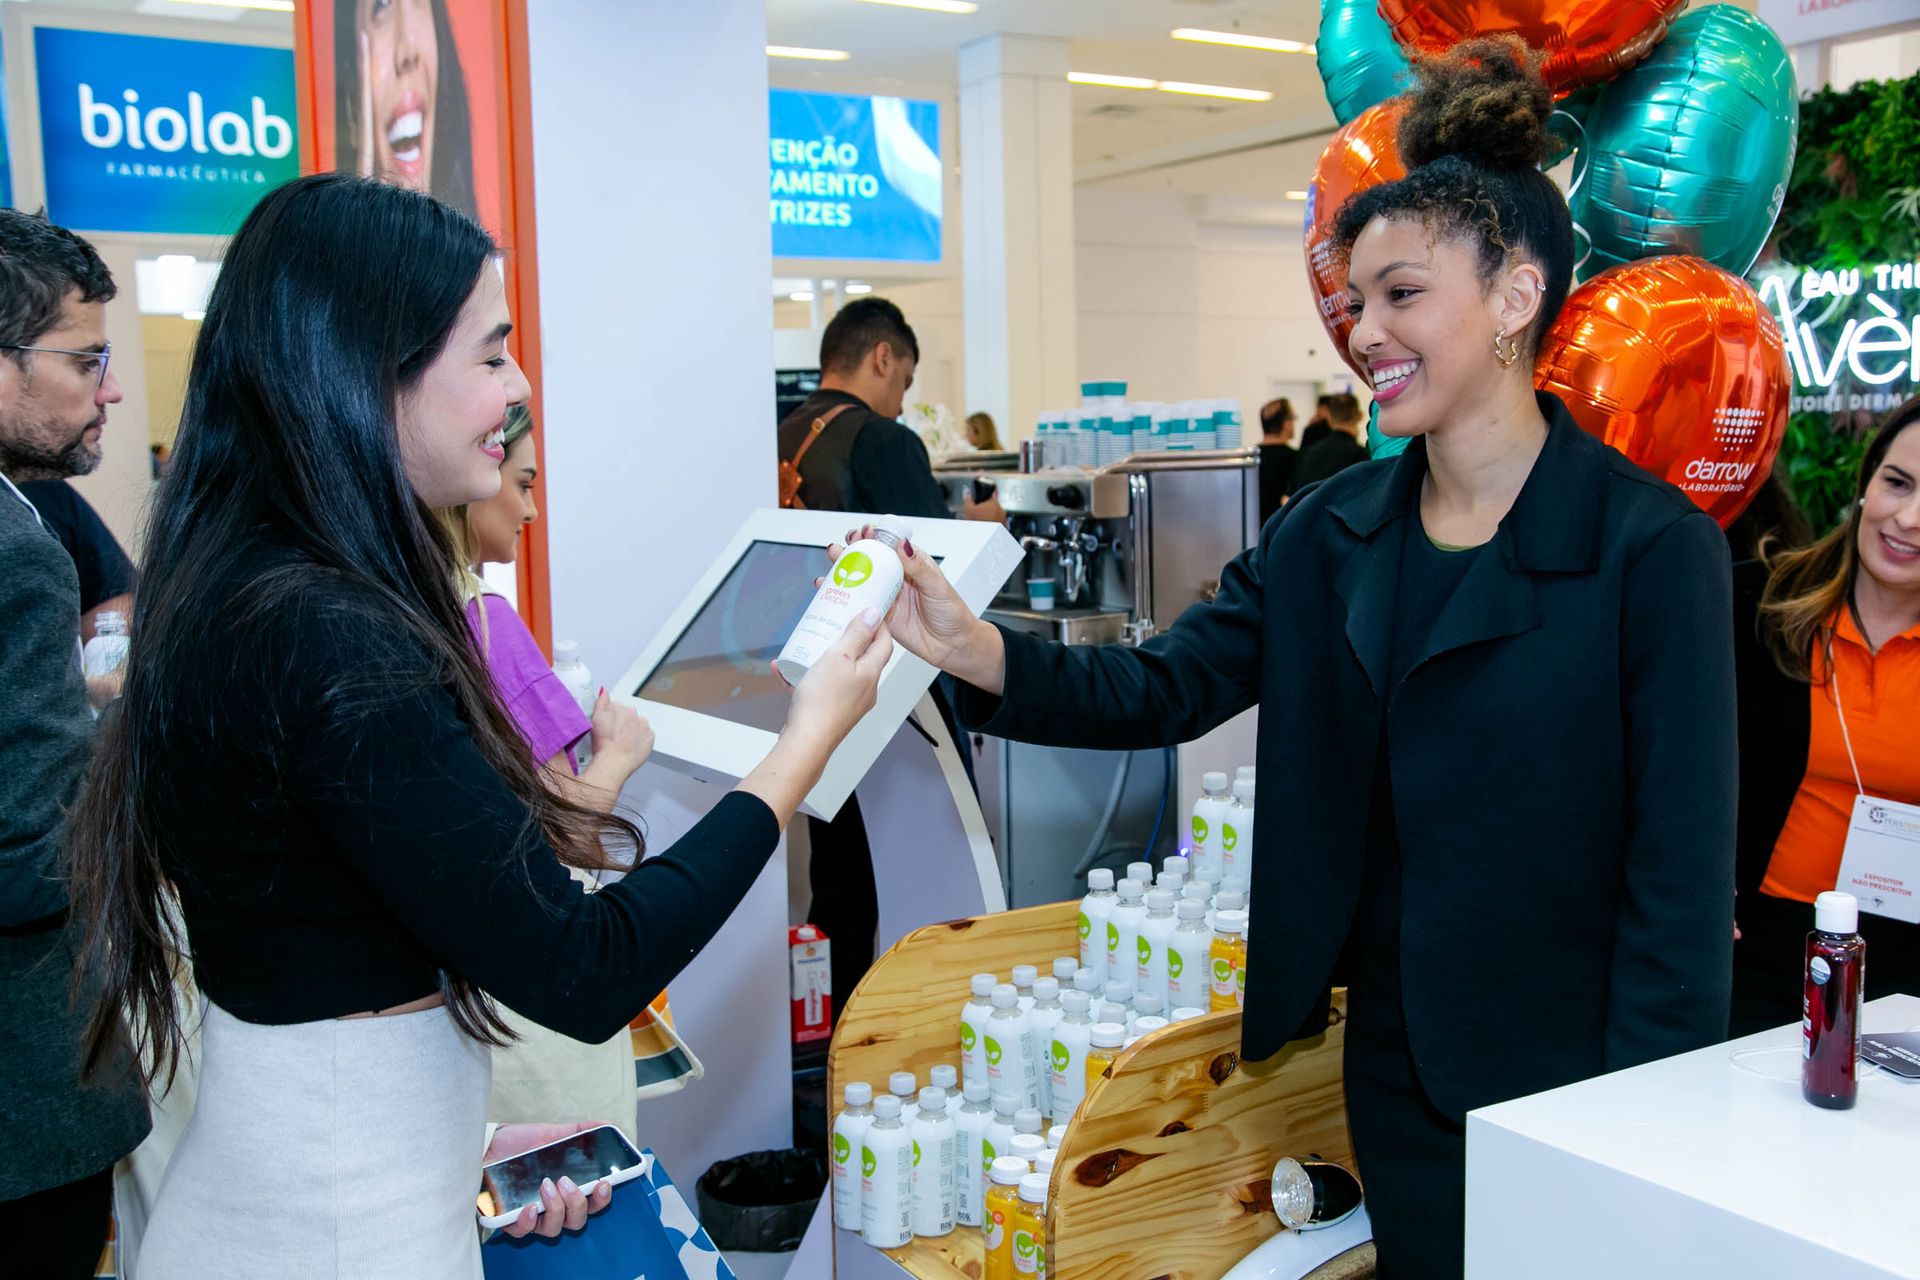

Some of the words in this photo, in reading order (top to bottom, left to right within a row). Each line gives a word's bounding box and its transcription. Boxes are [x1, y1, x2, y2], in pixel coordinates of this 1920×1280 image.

[78, 83, 293, 159] biolab
[769, 135, 859, 170] ENÇÃO
[106, 162, 265, 183] FARMACÊUTICA
[769, 169, 879, 198] AMENTO
[1801, 268, 1860, 299] EAU
[1758, 275, 1920, 387] Avè
[1685, 457, 1756, 481] darrow
[1681, 482, 1744, 492] LABORATÓRIO
[1864, 873, 1904, 887] EXPOSITOR
[1869, 882, 1912, 896] PRESCRITOR
